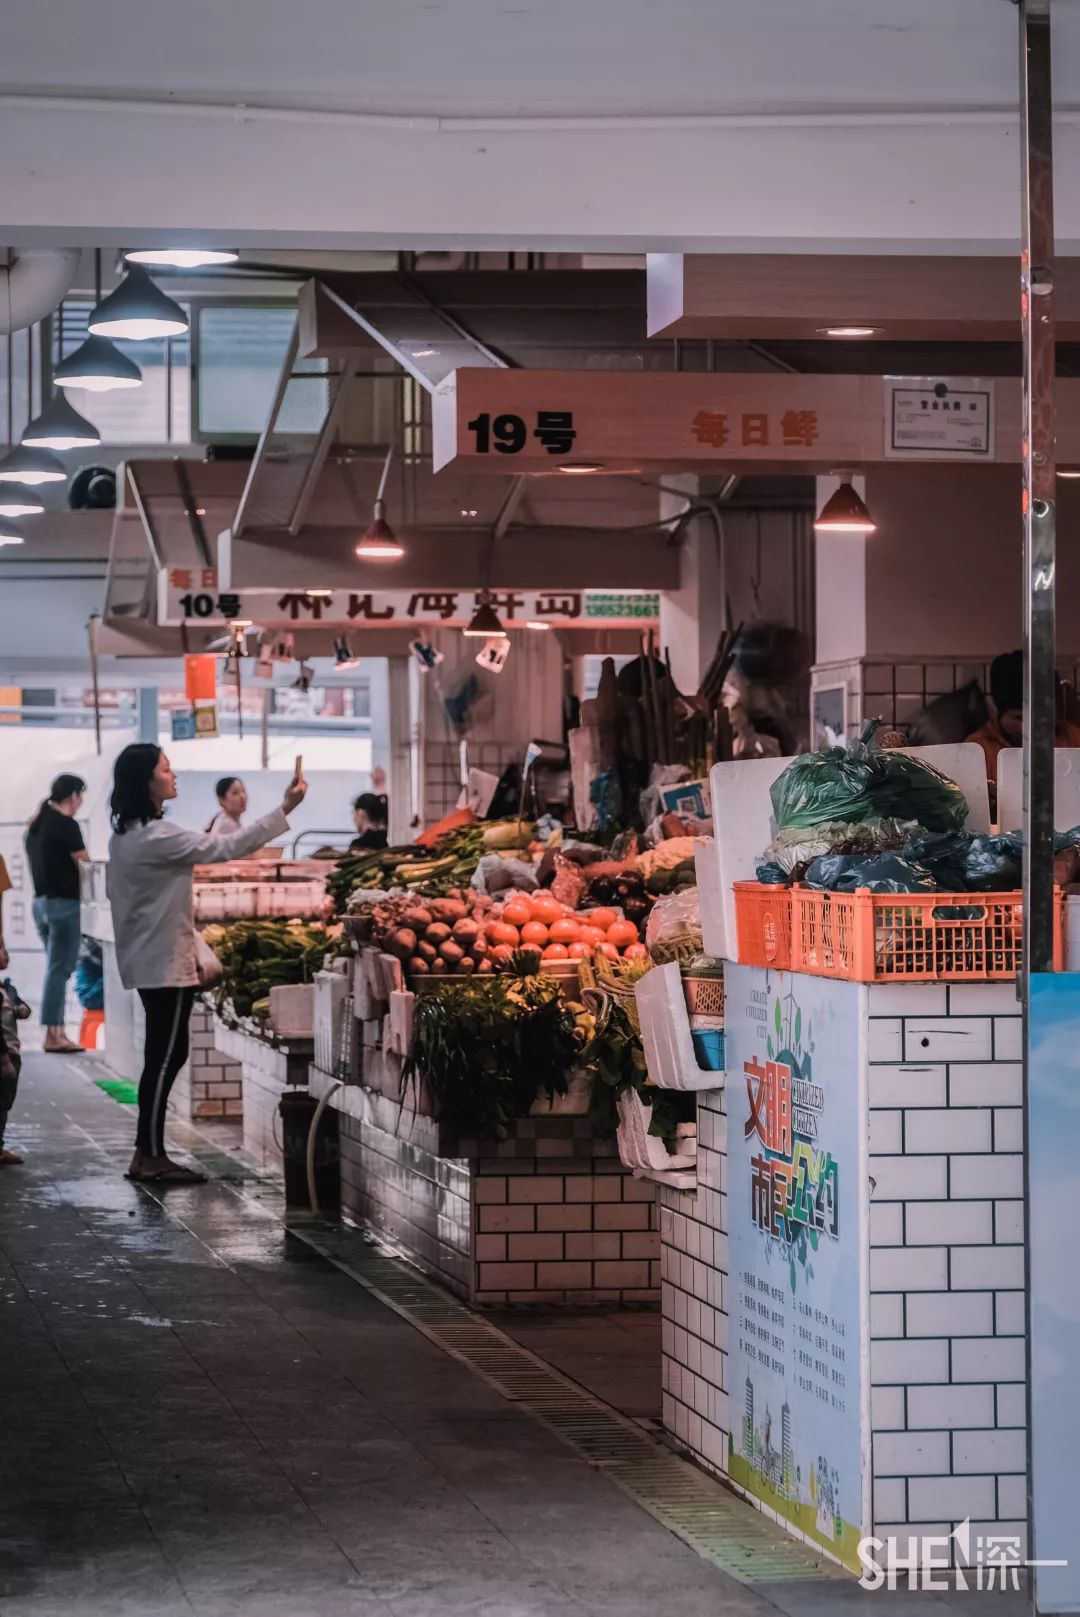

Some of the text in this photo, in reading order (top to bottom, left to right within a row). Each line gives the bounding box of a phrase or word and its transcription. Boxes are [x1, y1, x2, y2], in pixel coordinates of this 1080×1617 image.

[468, 411, 577, 454] 19号
[691, 410, 820, 447] 每日鲜
[179, 593, 242, 618] 10号
[744, 1056, 792, 1155] 文明
[750, 1141, 840, 1246] 市民公约
